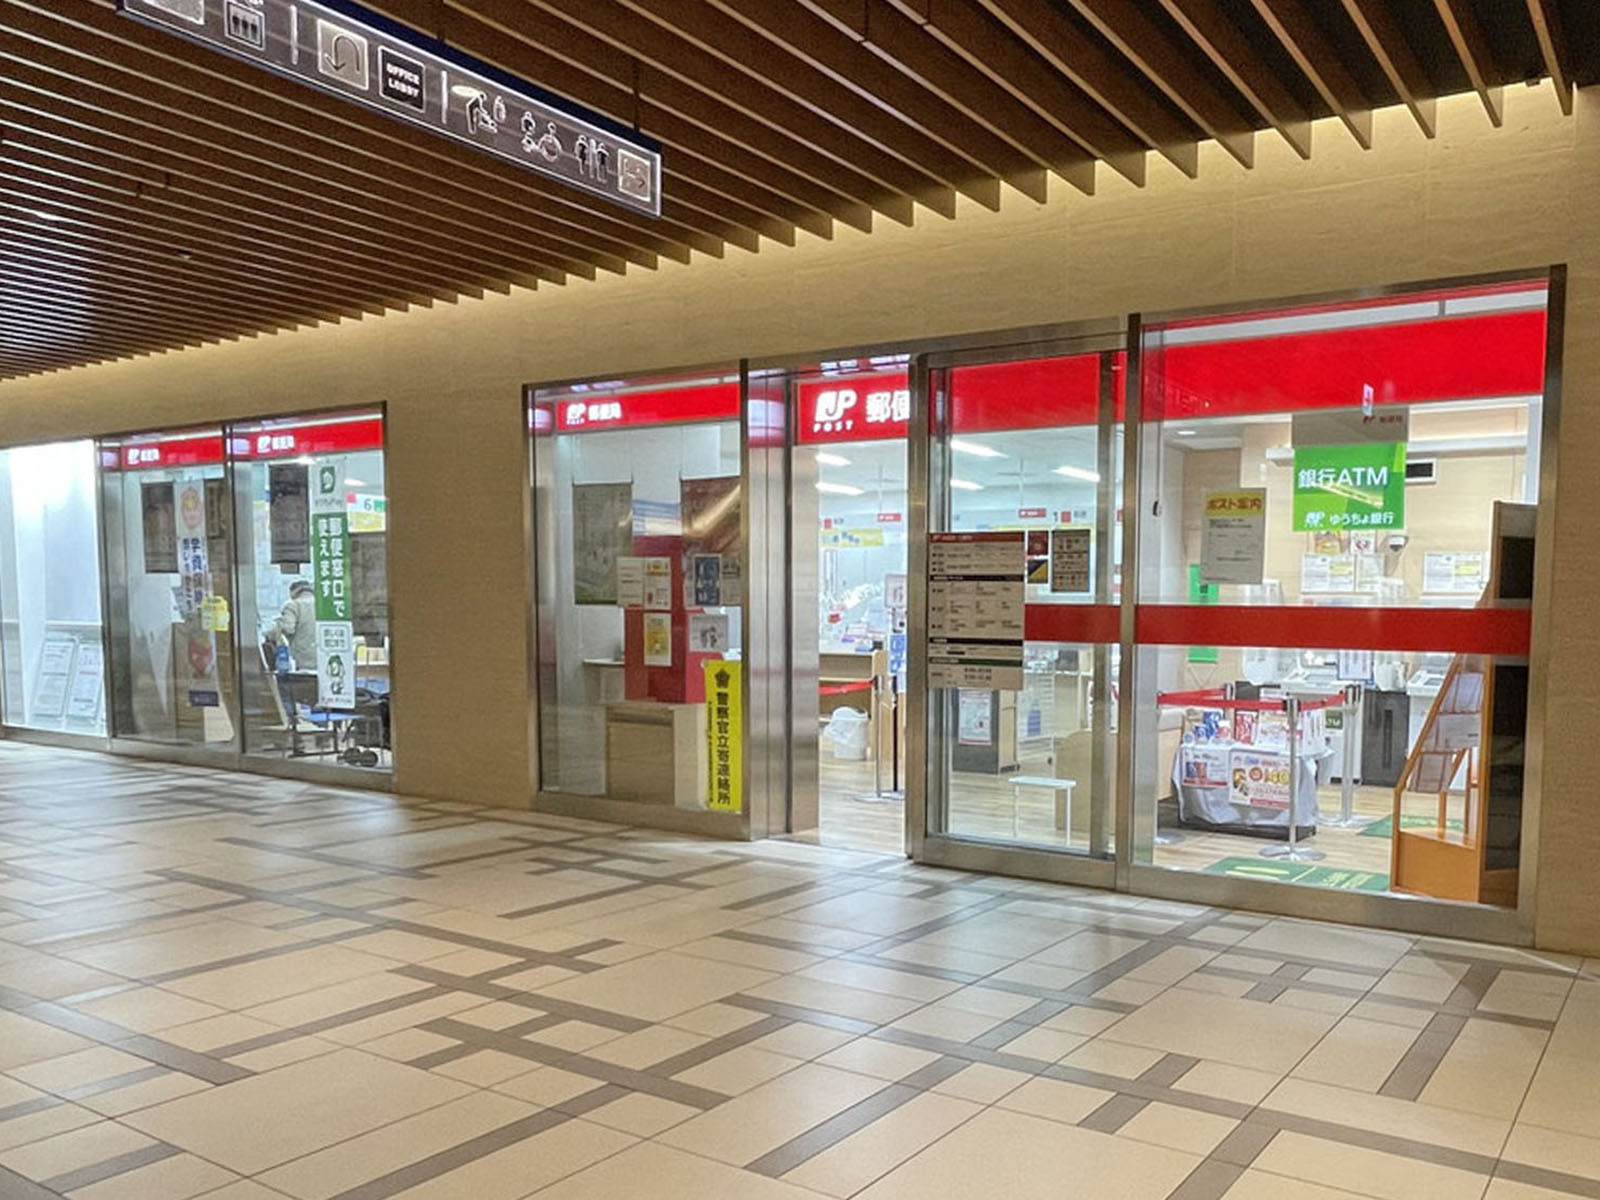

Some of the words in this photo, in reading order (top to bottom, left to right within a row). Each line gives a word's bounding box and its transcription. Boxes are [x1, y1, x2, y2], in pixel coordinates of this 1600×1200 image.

[386, 62, 420, 86] OFFICE
[388, 77, 420, 97] LOBBY
[812, 420, 854, 433] POST
[1298, 466, 1389, 489] 銀行ATM
[1329, 511, 1395, 526] ゆうちょ銀行
